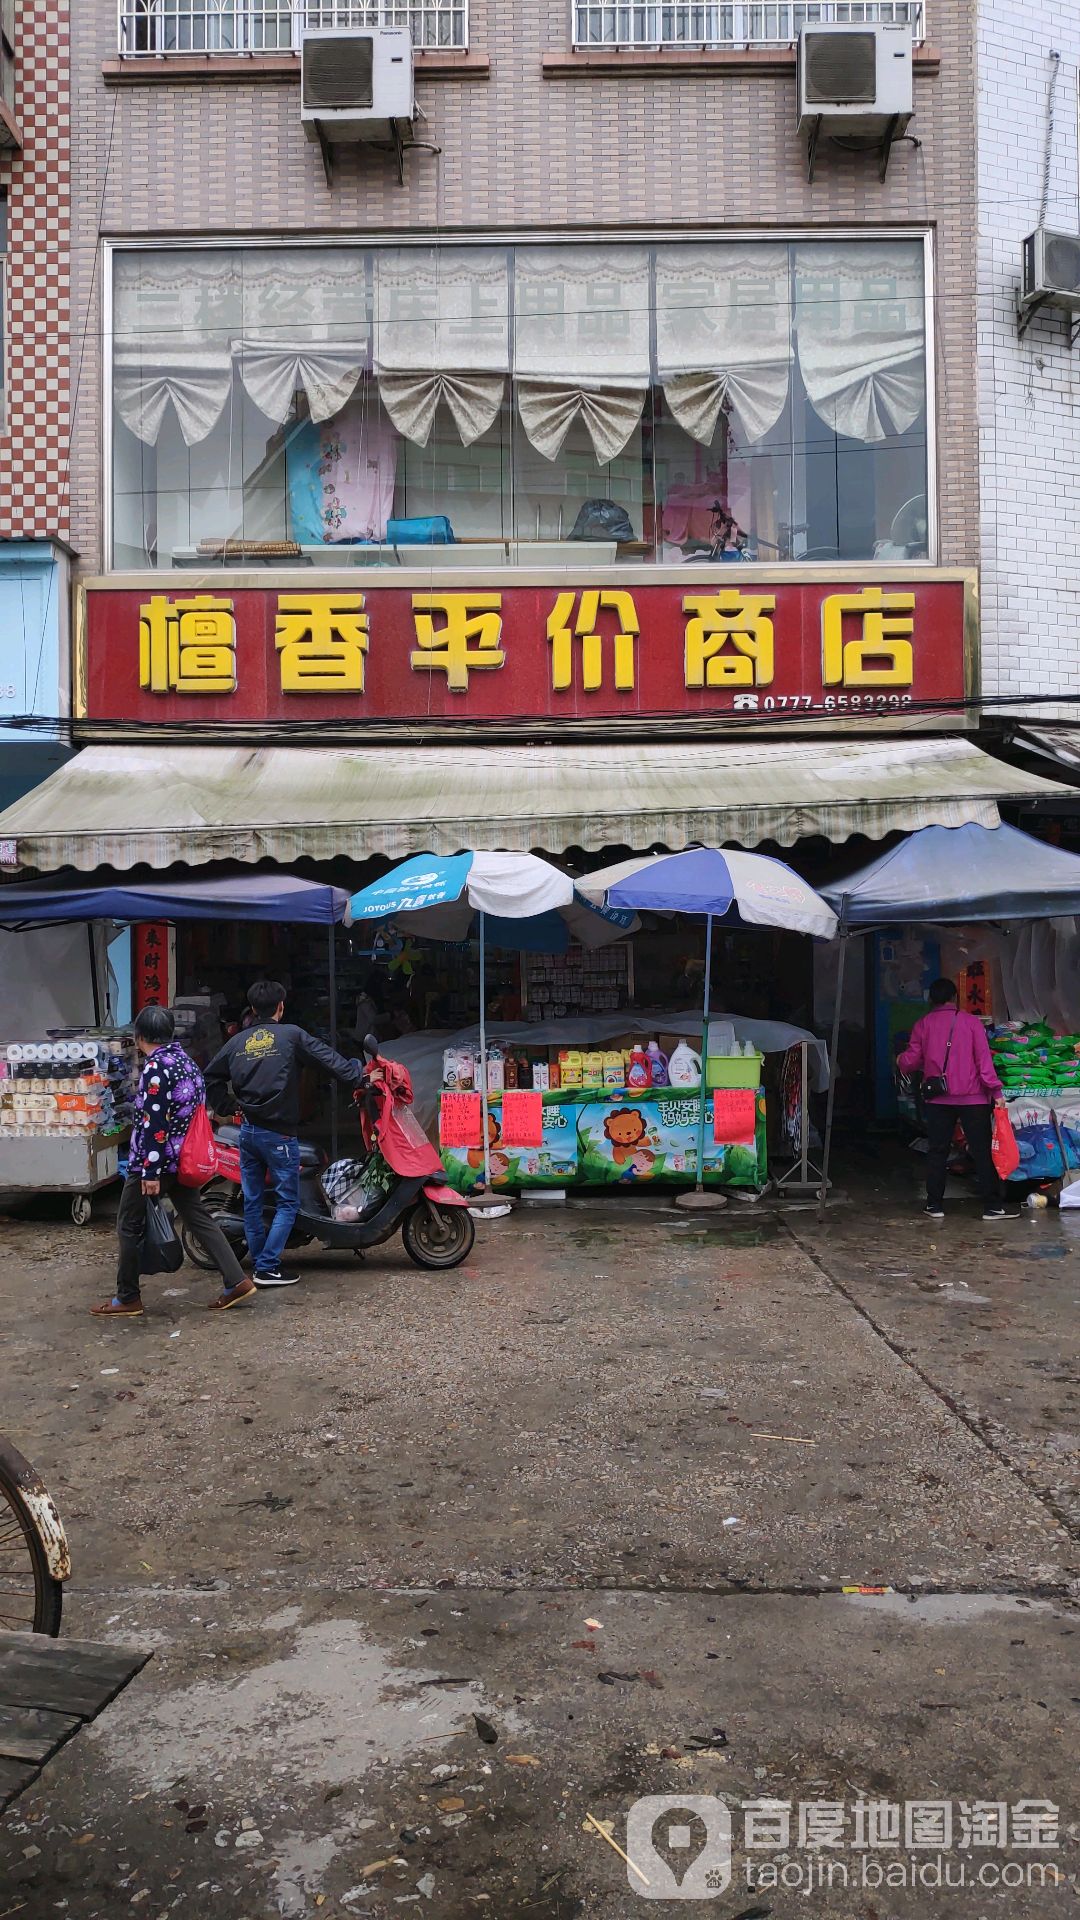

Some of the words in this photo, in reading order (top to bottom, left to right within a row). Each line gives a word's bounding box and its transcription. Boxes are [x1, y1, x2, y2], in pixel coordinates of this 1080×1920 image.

[139, 587, 916, 695] 檀香平价商店
[363, 901, 397, 913] JOYOUS
